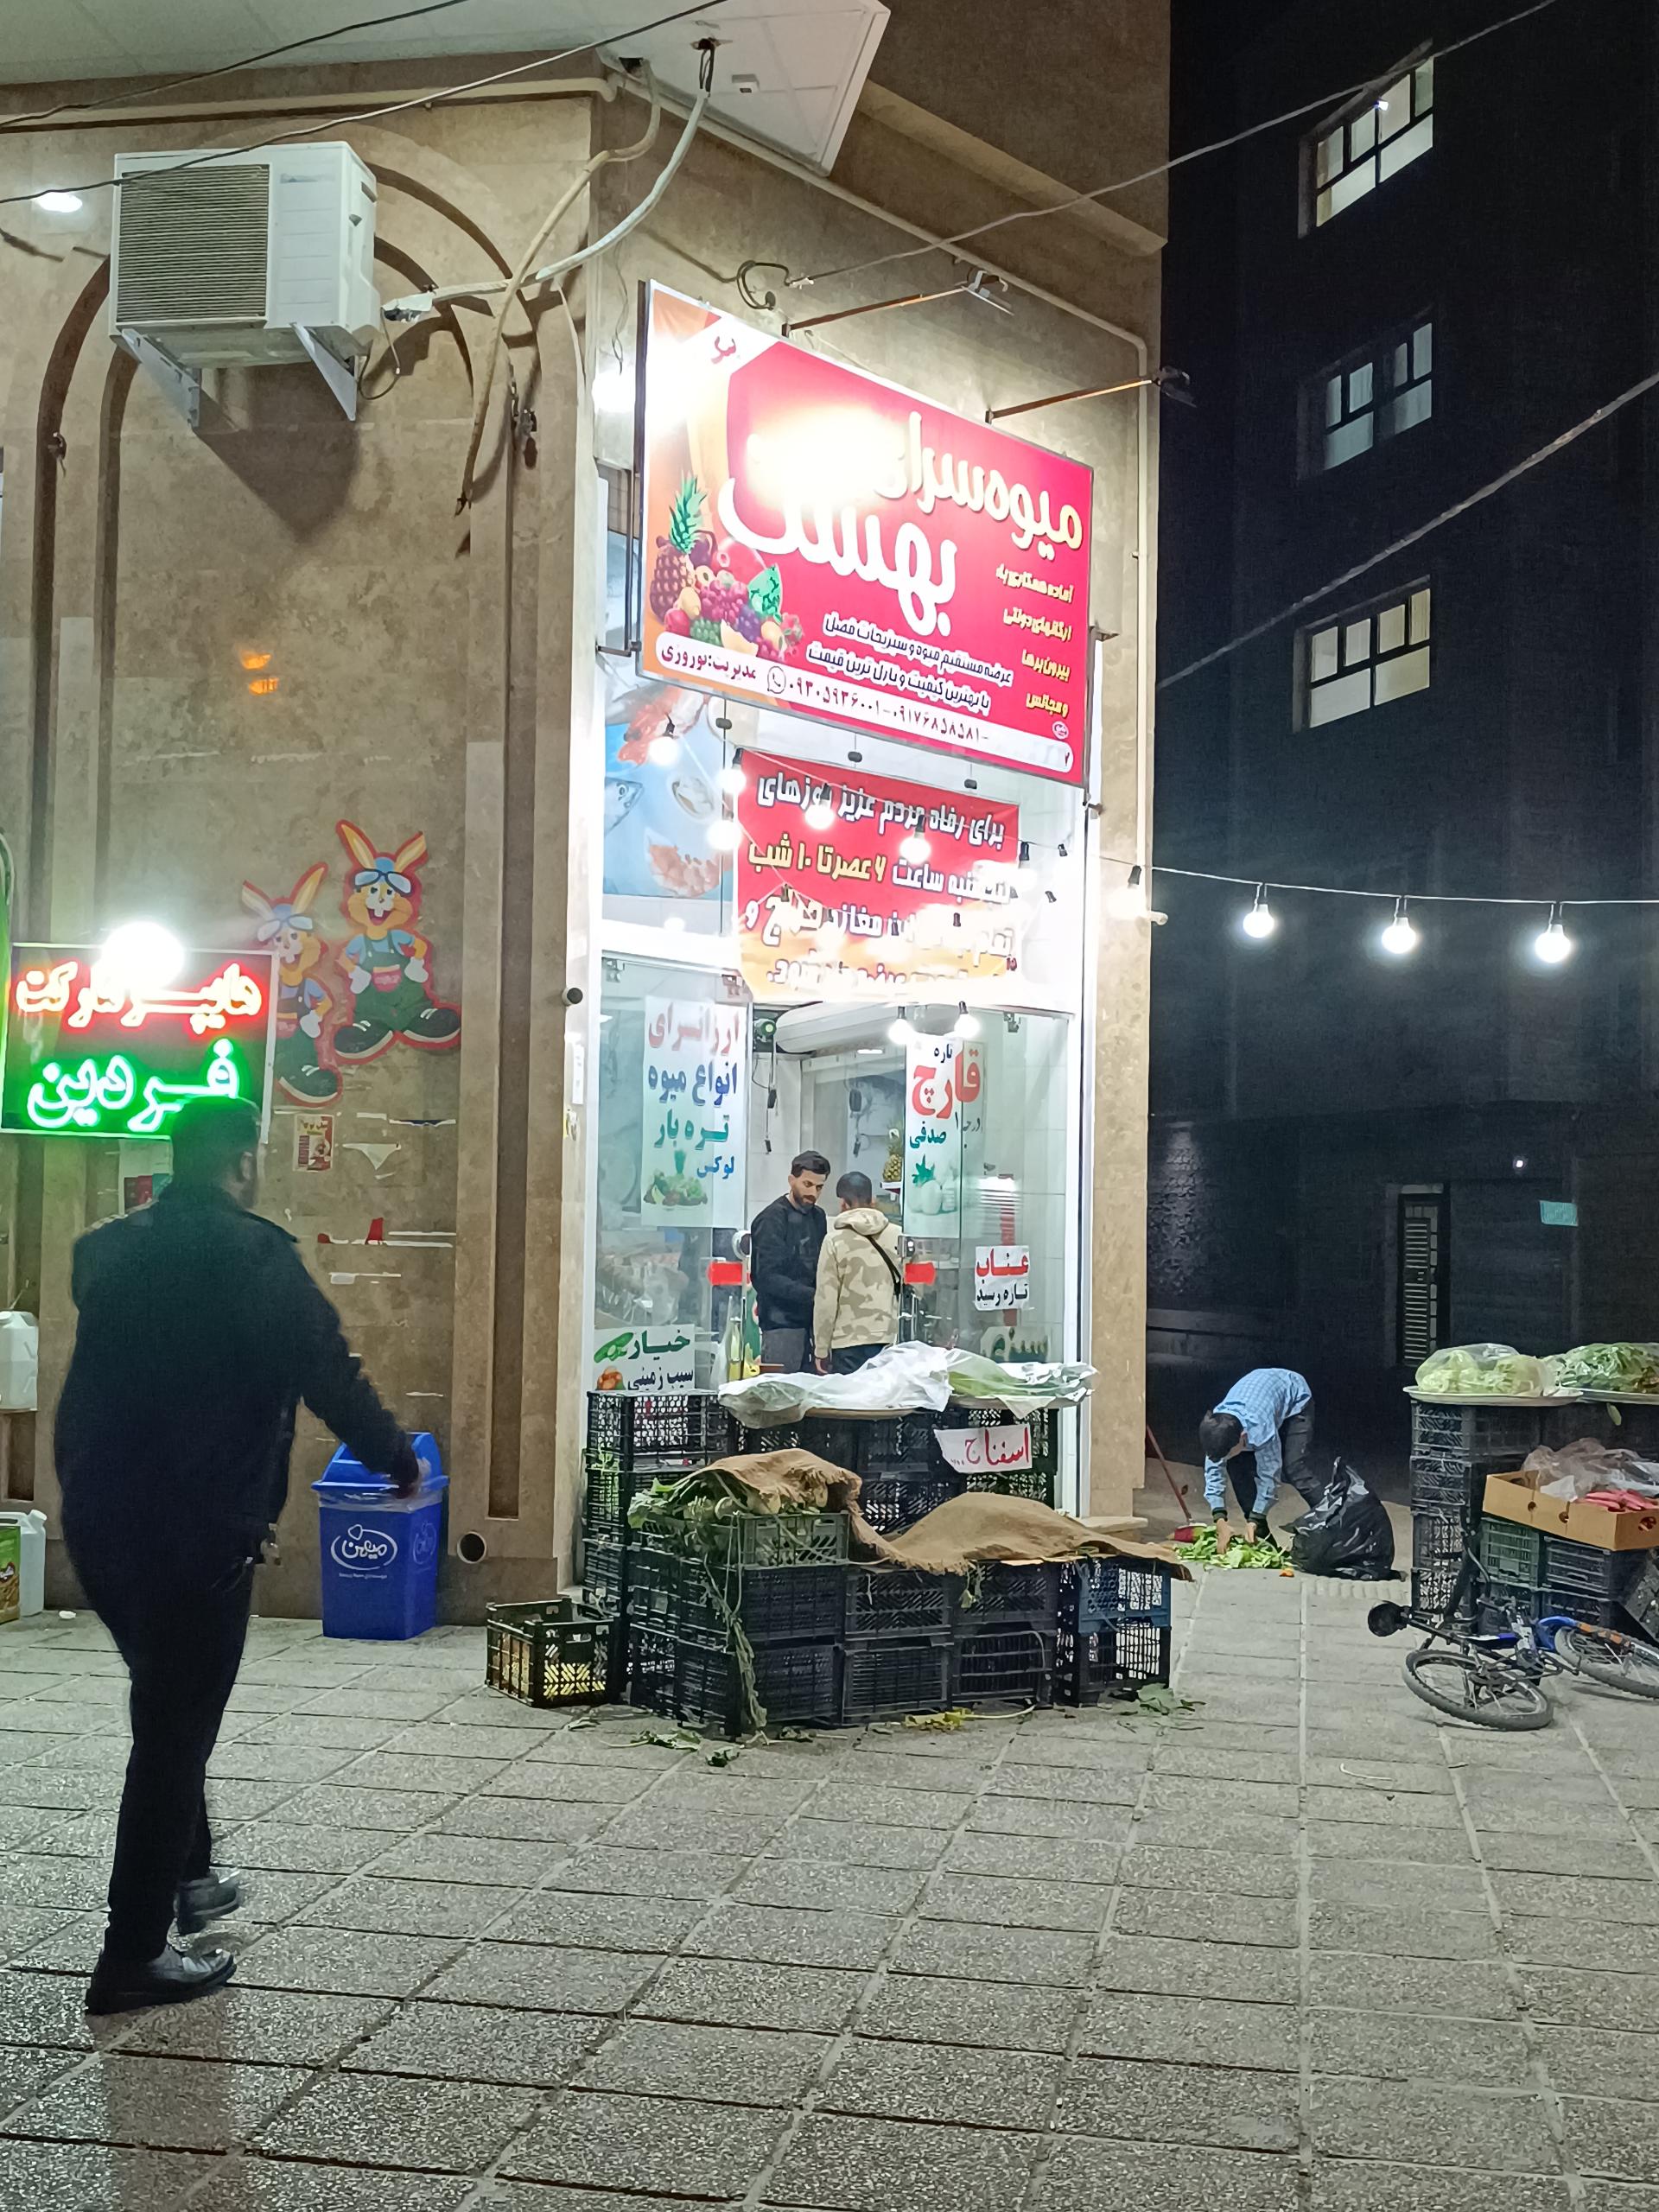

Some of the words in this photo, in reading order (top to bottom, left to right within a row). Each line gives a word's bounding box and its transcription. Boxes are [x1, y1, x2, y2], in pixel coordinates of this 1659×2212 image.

[824, 615, 855, 634] فصل
[856, 625, 907, 653] سبزیجات
[808, 645, 844, 669] قیمت
[908, 644, 915, 657] و
[916, 644, 940, 664] میوه
[941, 652, 983, 674] مستقیم
[899, 674, 906, 688] و
[907, 674, 944, 698] کیفیت
[983, 666, 1013, 684] عرضه
[944, 685, 980, 709] بهترین
[981, 693, 990, 715] با
[756, 772, 833, 811] وزهای
[837, 785, 875, 821] عزیز
[878, 800, 925, 835] مردم
[929, 804, 964, 840] رفاه
[969, 815, 1006, 850] برای
[747, 831, 794, 874] شب
[892, 856, 944, 893] ساعت
[745, 899, 760, 930] و
[26, 1038, 239, 1133] فردین
[647, 1065, 688, 1103] میوه
[691, 1059, 738, 1107] انواع
[911, 1048, 981, 1119] قارچ
[653, 1108, 680, 1147] بار
[908, 1120, 948, 1150] صدفی
[976, 1248, 1029, 1284] عناب
[976, 1287, 1001, 1306] رسید
[627, 1329, 691, 1361] خیار
[627, 1366, 664, 1391] زمینی
[666, 1369, 694, 1389] سیب
